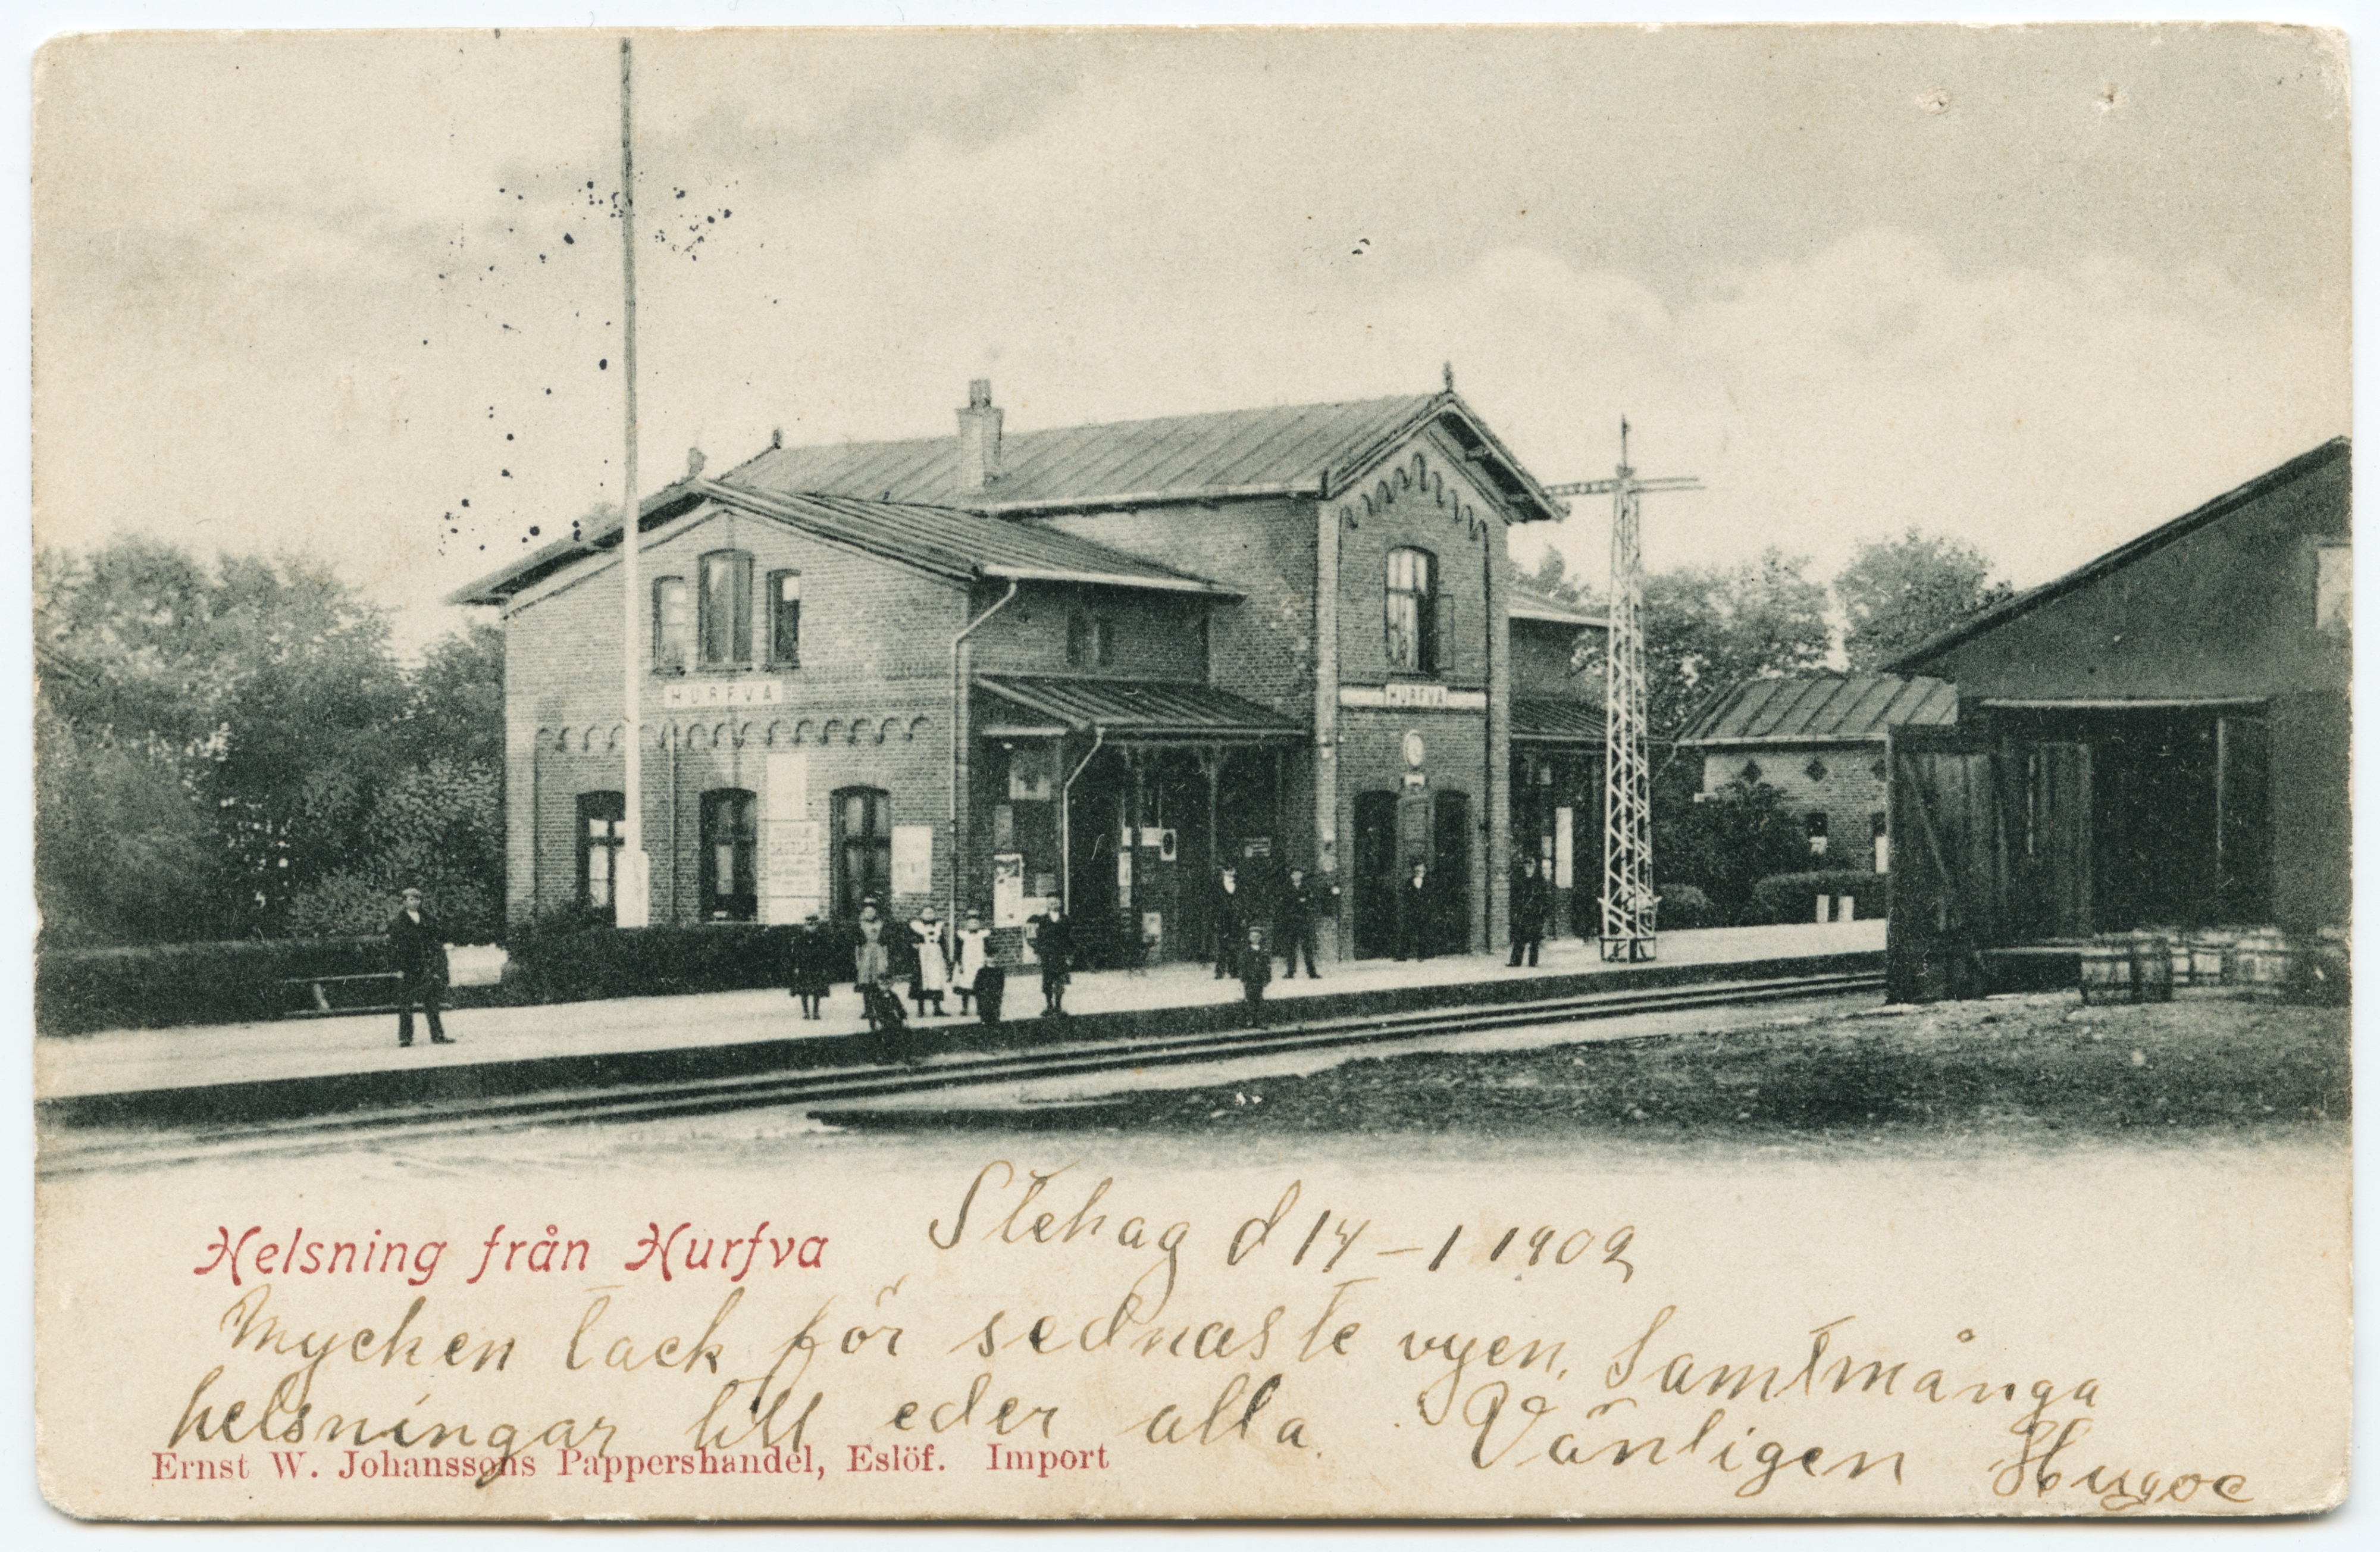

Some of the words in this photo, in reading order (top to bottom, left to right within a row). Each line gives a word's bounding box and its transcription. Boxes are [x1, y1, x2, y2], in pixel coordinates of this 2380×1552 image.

[671, 684, 773, 706] HURFVA
[928, 1159, 1190, 1323] Stehag
[1227, 1179, 1301, 1266] d
[1490, 1224, 1636, 1284] 1902
[565, 1284, 746, 1374] tack
[749, 1274, 908, 1425] för
[167, 1364, 618, 1489] helsningar
[685, 1375, 824, 1453] till
[876, 1371, 1059, 1440] eder
[1463, 1381, 1905, 1498] Vänligen
